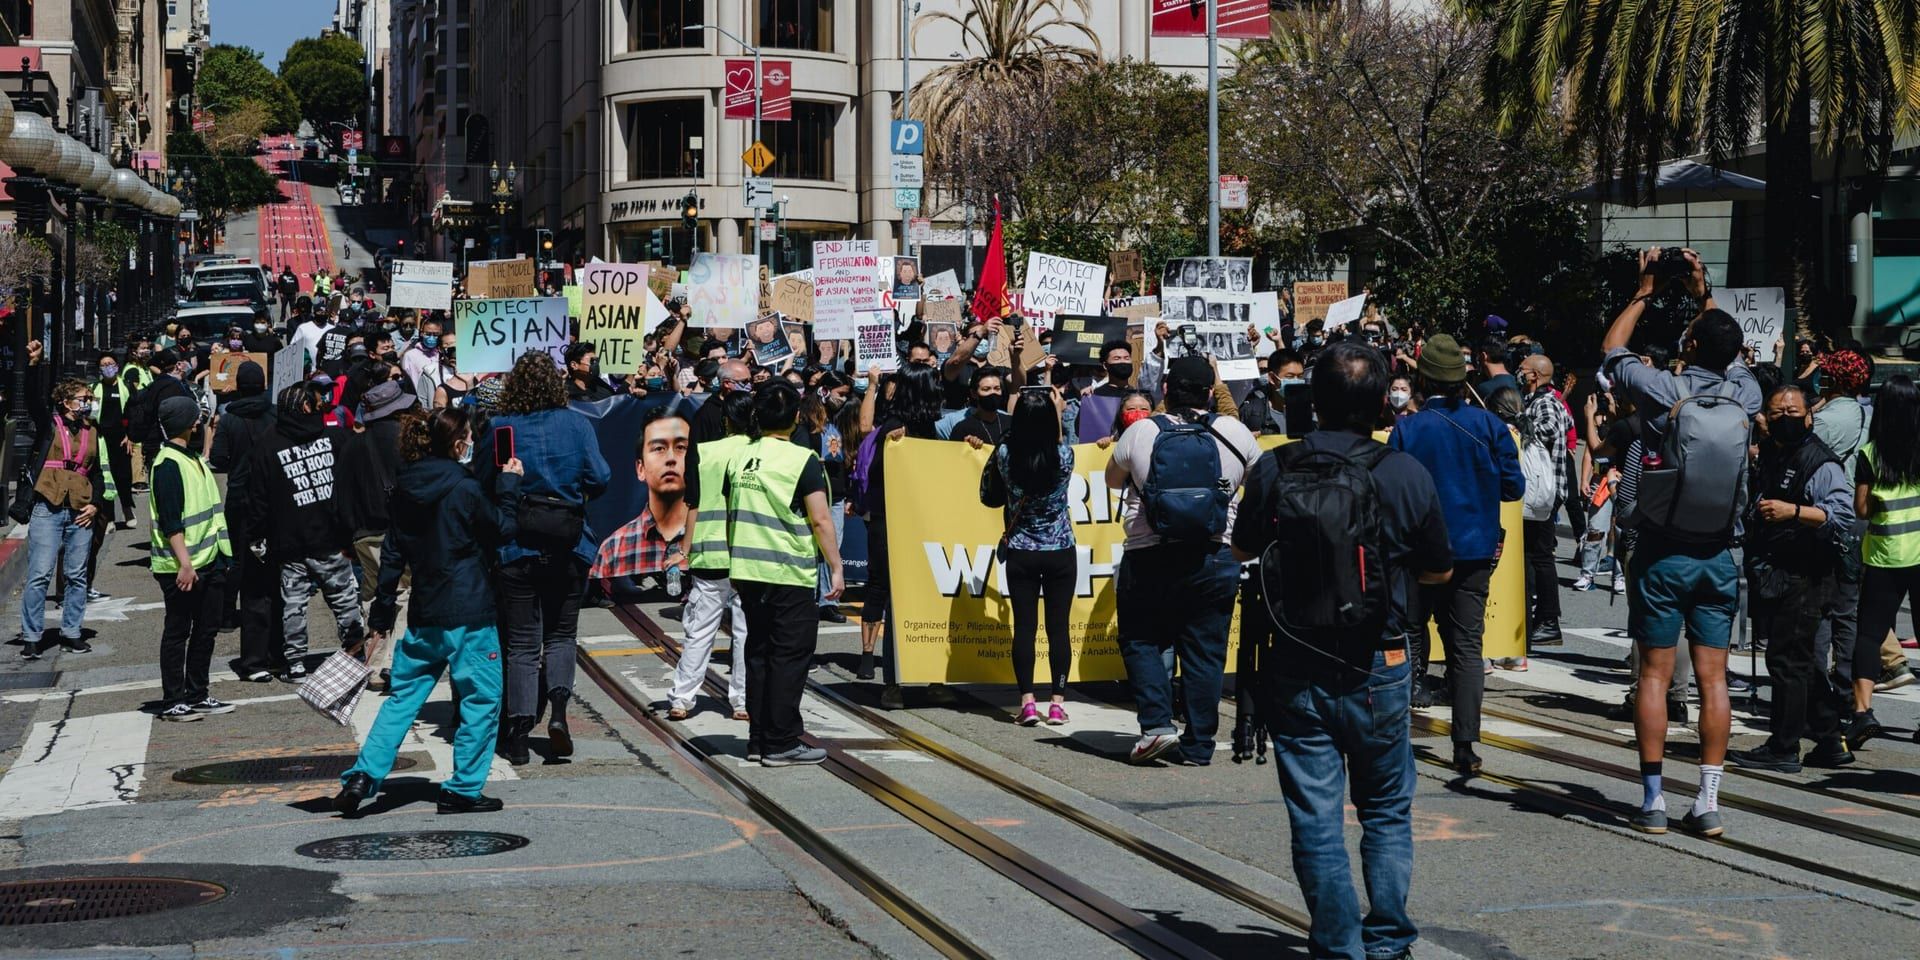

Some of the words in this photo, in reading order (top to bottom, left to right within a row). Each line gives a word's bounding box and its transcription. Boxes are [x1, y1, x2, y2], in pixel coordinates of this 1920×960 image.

[661, 198, 705, 211] AVEE
[816, 242, 843, 255] END
[847, 241, 870, 252] THE
[493, 263, 505, 278] THE
[507, 261, 531, 276] MODEL
[690, 255, 753, 288] STOP
[820, 256, 878, 271] FETISHIZATION
[1038, 256, 1099, 280] PROTECT
[588, 270, 639, 296] STOP
[815, 289, 824, 297] OF
[826, 287, 850, 296] ASIAN
[852, 287, 876, 295] WOMEN
[1037, 274, 1085, 297] ASIAN
[455, 300, 543, 319] PROTECT
[1030, 291, 1087, 314] WOMEN
[1109, 297, 1134, 313] NOT
[1734, 293, 1758, 314] WE
[585, 305, 641, 330] ASIAN
[1032, 318, 1045, 327] IS
[472, 314, 566, 347] ASIAN
[858, 324, 892, 333] QUEER
[858, 331, 892, 339] ASIAN
[586, 338, 634, 366] ATE
[277, 448, 292, 465] IT
[292, 437, 332, 460] TAKES
[283, 460, 307, 479] THE
[305, 452, 334, 472] HOOD
[293, 475, 310, 490] TO
[293, 488, 317, 507] THE
[923, 541, 1125, 598] WH
[903, 620, 947, 632] Organized
[949, 621, 963, 632] By:
[967, 621, 995, 633] Pilipino
[905, 634, 944, 644] Northern
[946, 635, 987, 645] California
[1092, 634, 1118, 643] Allian
[977, 650, 1005, 661] Malaya
